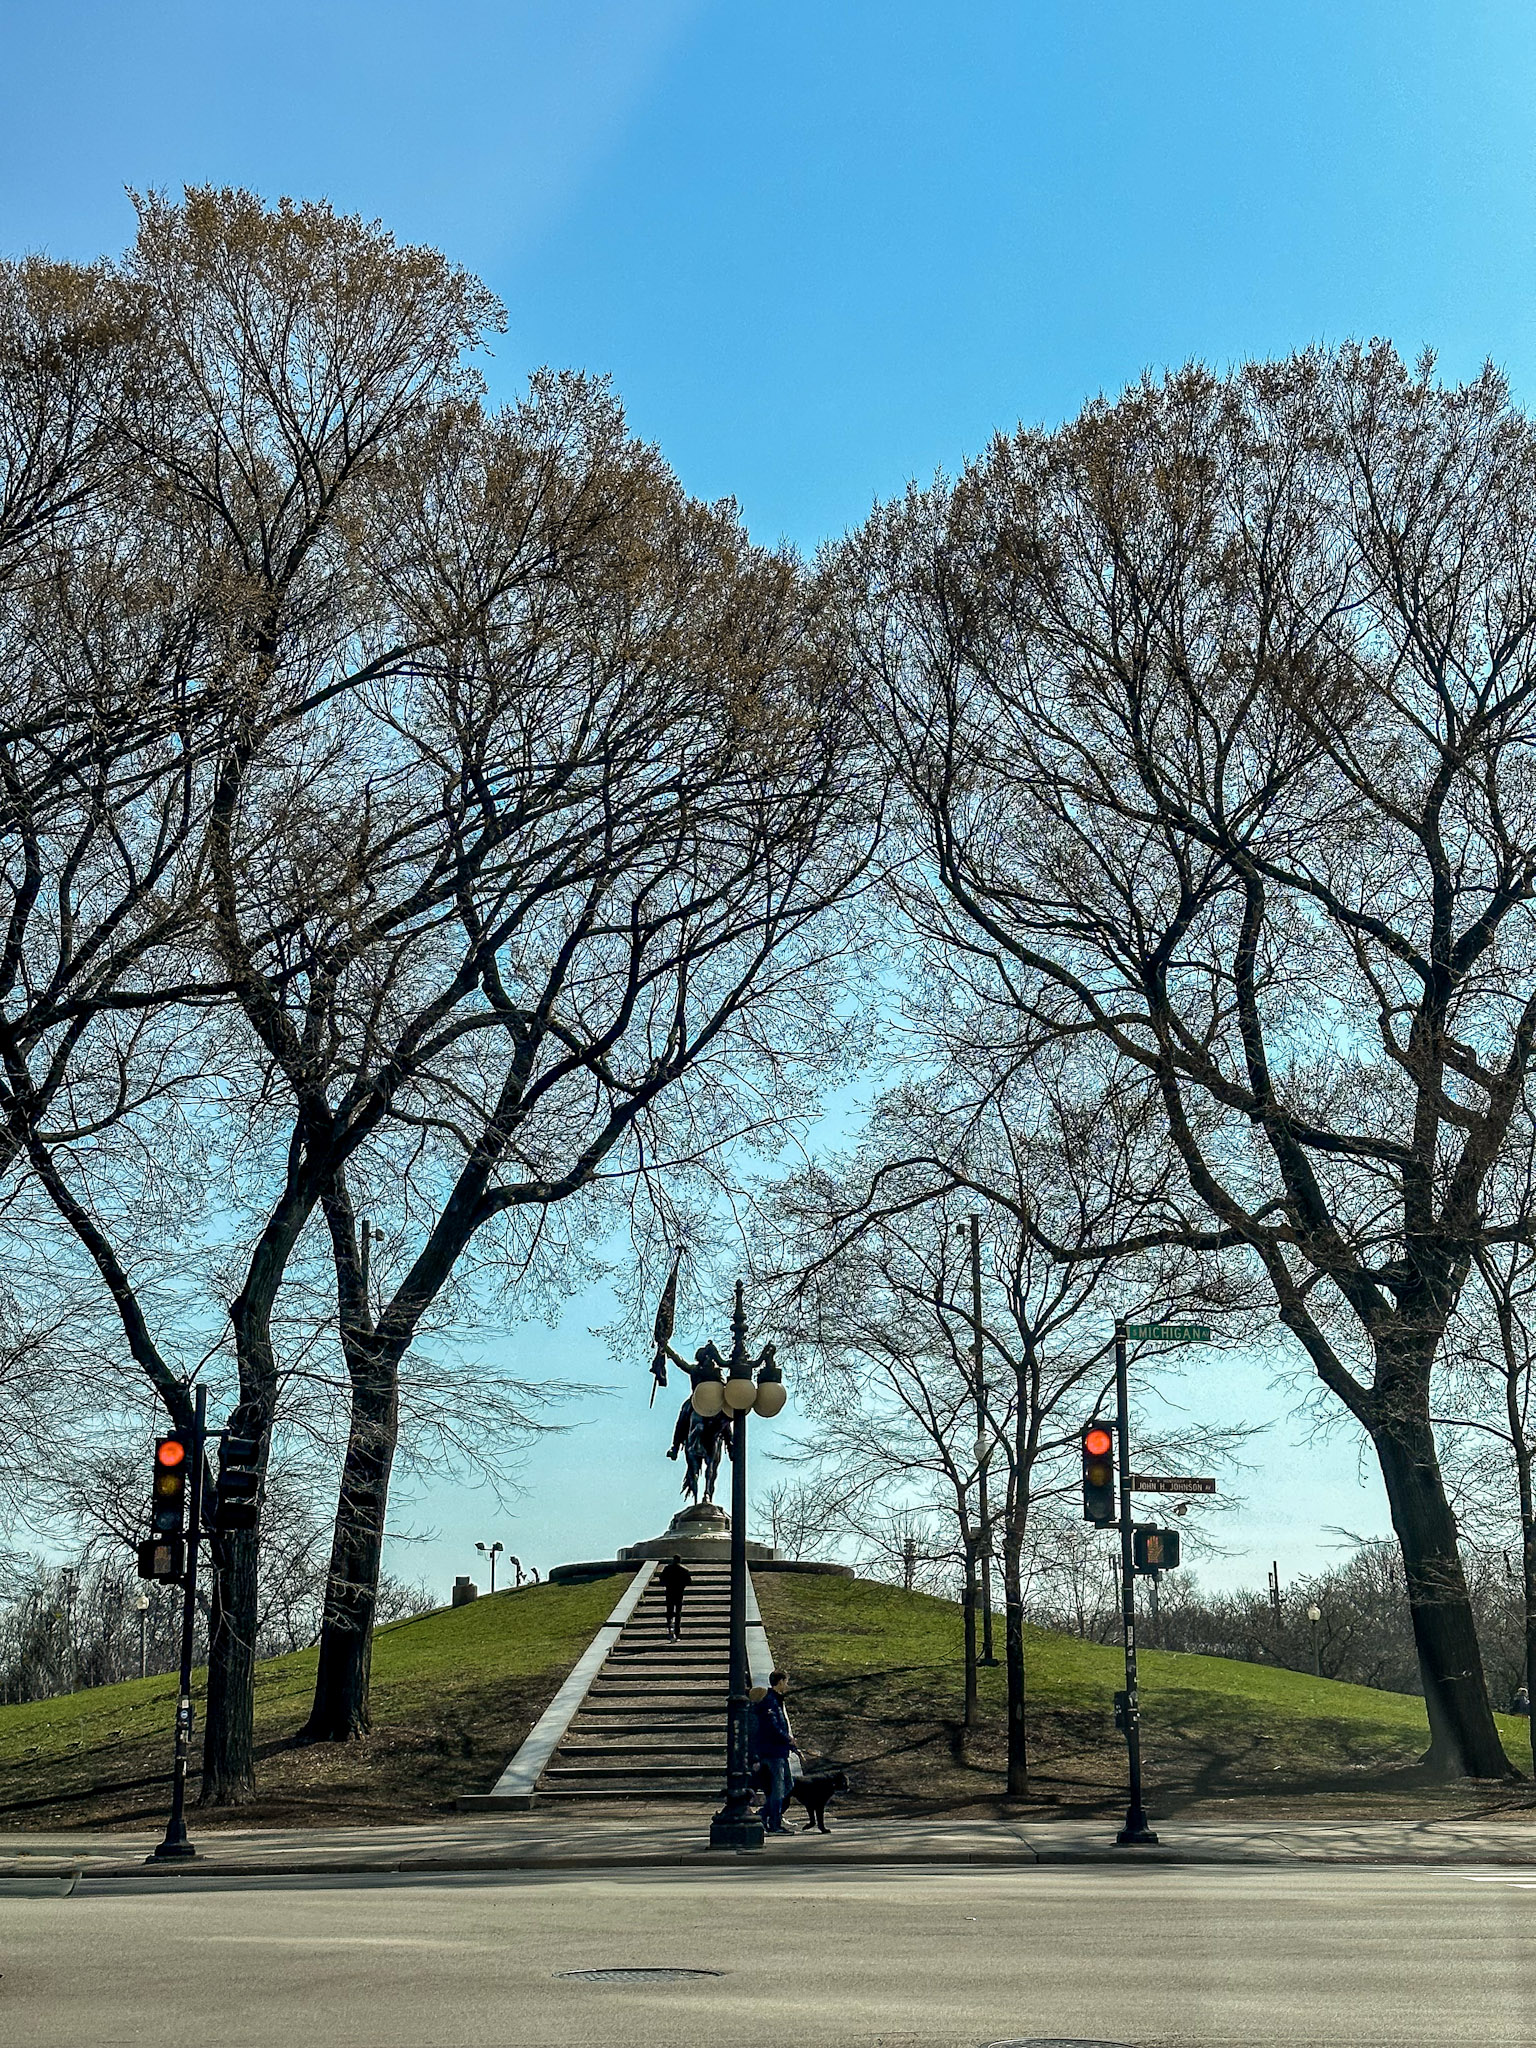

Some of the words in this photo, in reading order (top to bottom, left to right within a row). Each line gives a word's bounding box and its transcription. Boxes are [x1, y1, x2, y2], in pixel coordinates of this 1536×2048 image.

[1138, 1327, 1200, 1339] MICHIGAN
[1138, 1482, 1157, 1491] JOHN
[1169, 1483, 1203, 1492] JOHNSON
